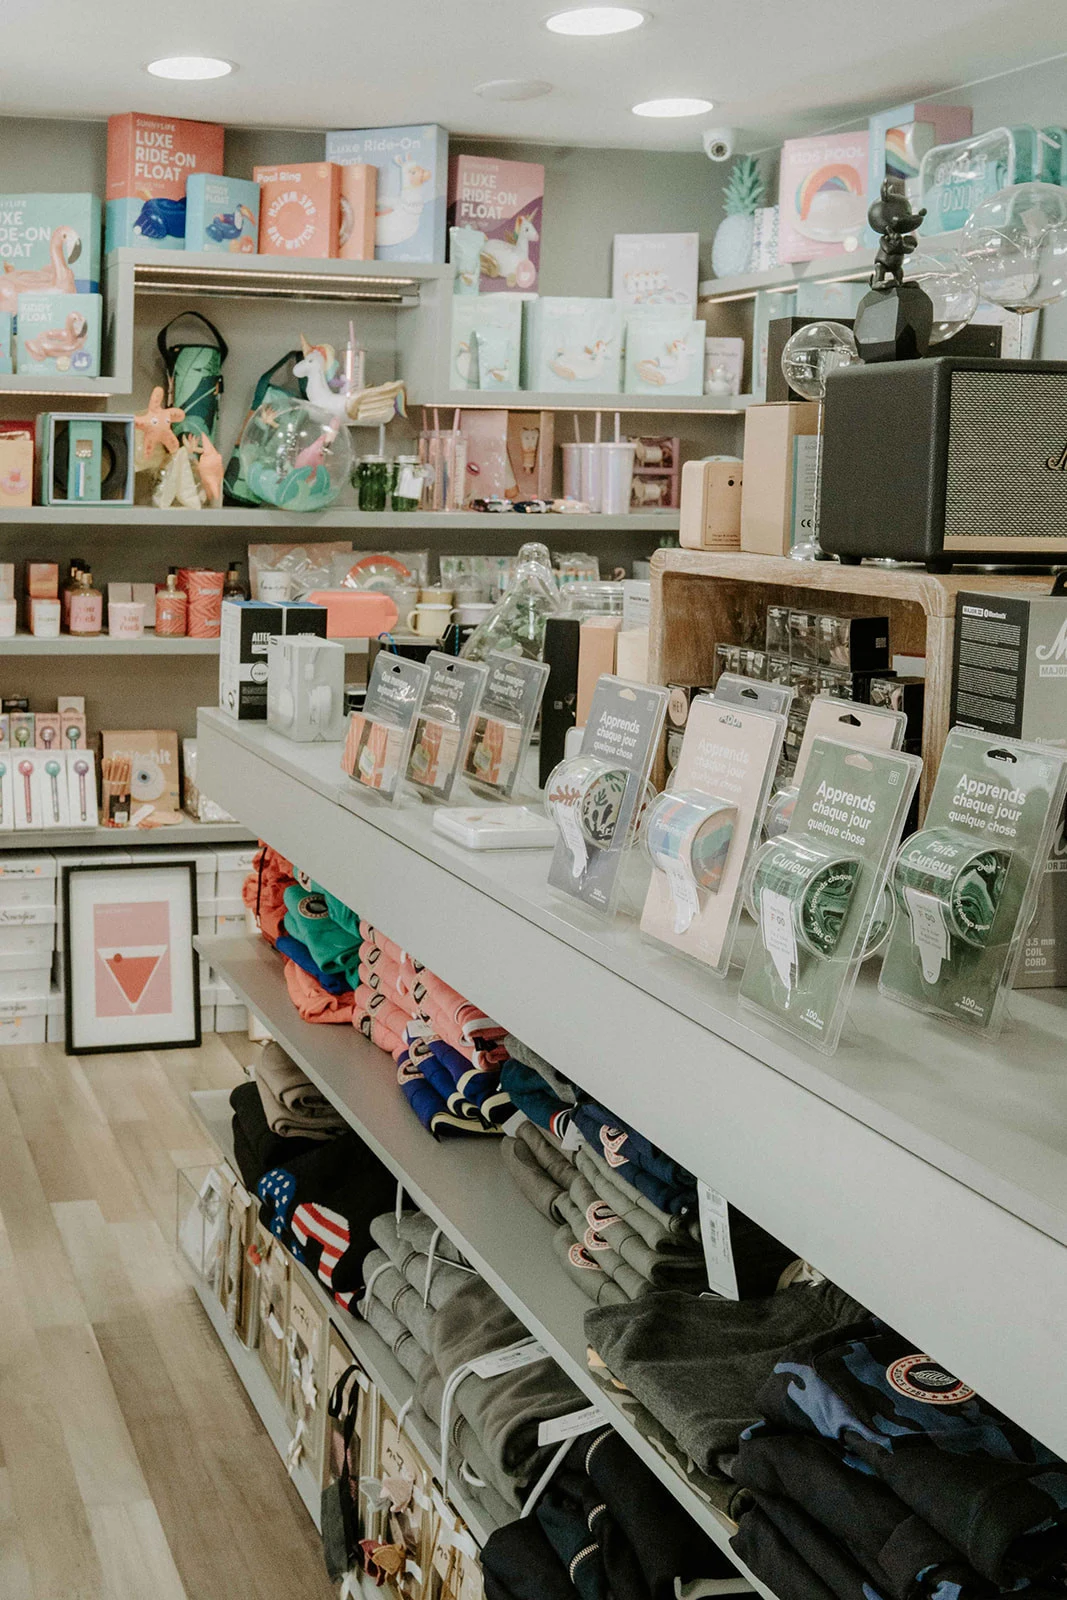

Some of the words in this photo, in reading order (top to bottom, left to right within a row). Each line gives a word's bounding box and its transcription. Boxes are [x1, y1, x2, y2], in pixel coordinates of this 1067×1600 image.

[135, 130, 173, 149] LUXE
[329, 142, 361, 154] Luxe
[363, 136, 421, 153] Ride-On
[134, 146, 197, 168] RIDE-ON
[134, 163, 182, 182] FLOAT
[257, 173, 278, 183] Pool
[279, 171, 302, 183] Ring
[462, 171, 497, 189] LUXE
[461, 187, 518, 206] RIDE-ON
[460, 202, 504, 219] FLOAT
[600, 711, 641, 734] Apprends
[596, 726, 623, 744] chaque
[619, 733, 637, 748] jour
[615, 747, 634, 760] chose
[697, 738, 750, 765] Apprends
[815, 780, 877, 814] Apprends
[956, 773, 1027, 805] Apprends
[811, 799, 849, 823] chaque
[848, 811, 872, 831] jour
[952, 793, 995, 815] chaque
[994, 803, 1023, 822] jour
[807, 818, 840, 837] quelque
[840, 829, 866, 846] chose
[948, 810, 986, 829] quelque
[986, 821, 1017, 838] chose
[925, 840, 959, 858] Faits
[771, 853, 814, 879] Curieux
[907, 849, 956, 877] Curieux
[827, 874, 853, 884] chaque
[1025, 938, 1039, 947] 3.5
[1040, 938, 1056, 946] mm
[1025, 947, 1044, 957] COIL
[1024, 957, 1047, 967] CORD
[961, 996, 976, 1009] 100
[805, 1008, 818, 1021] 100
